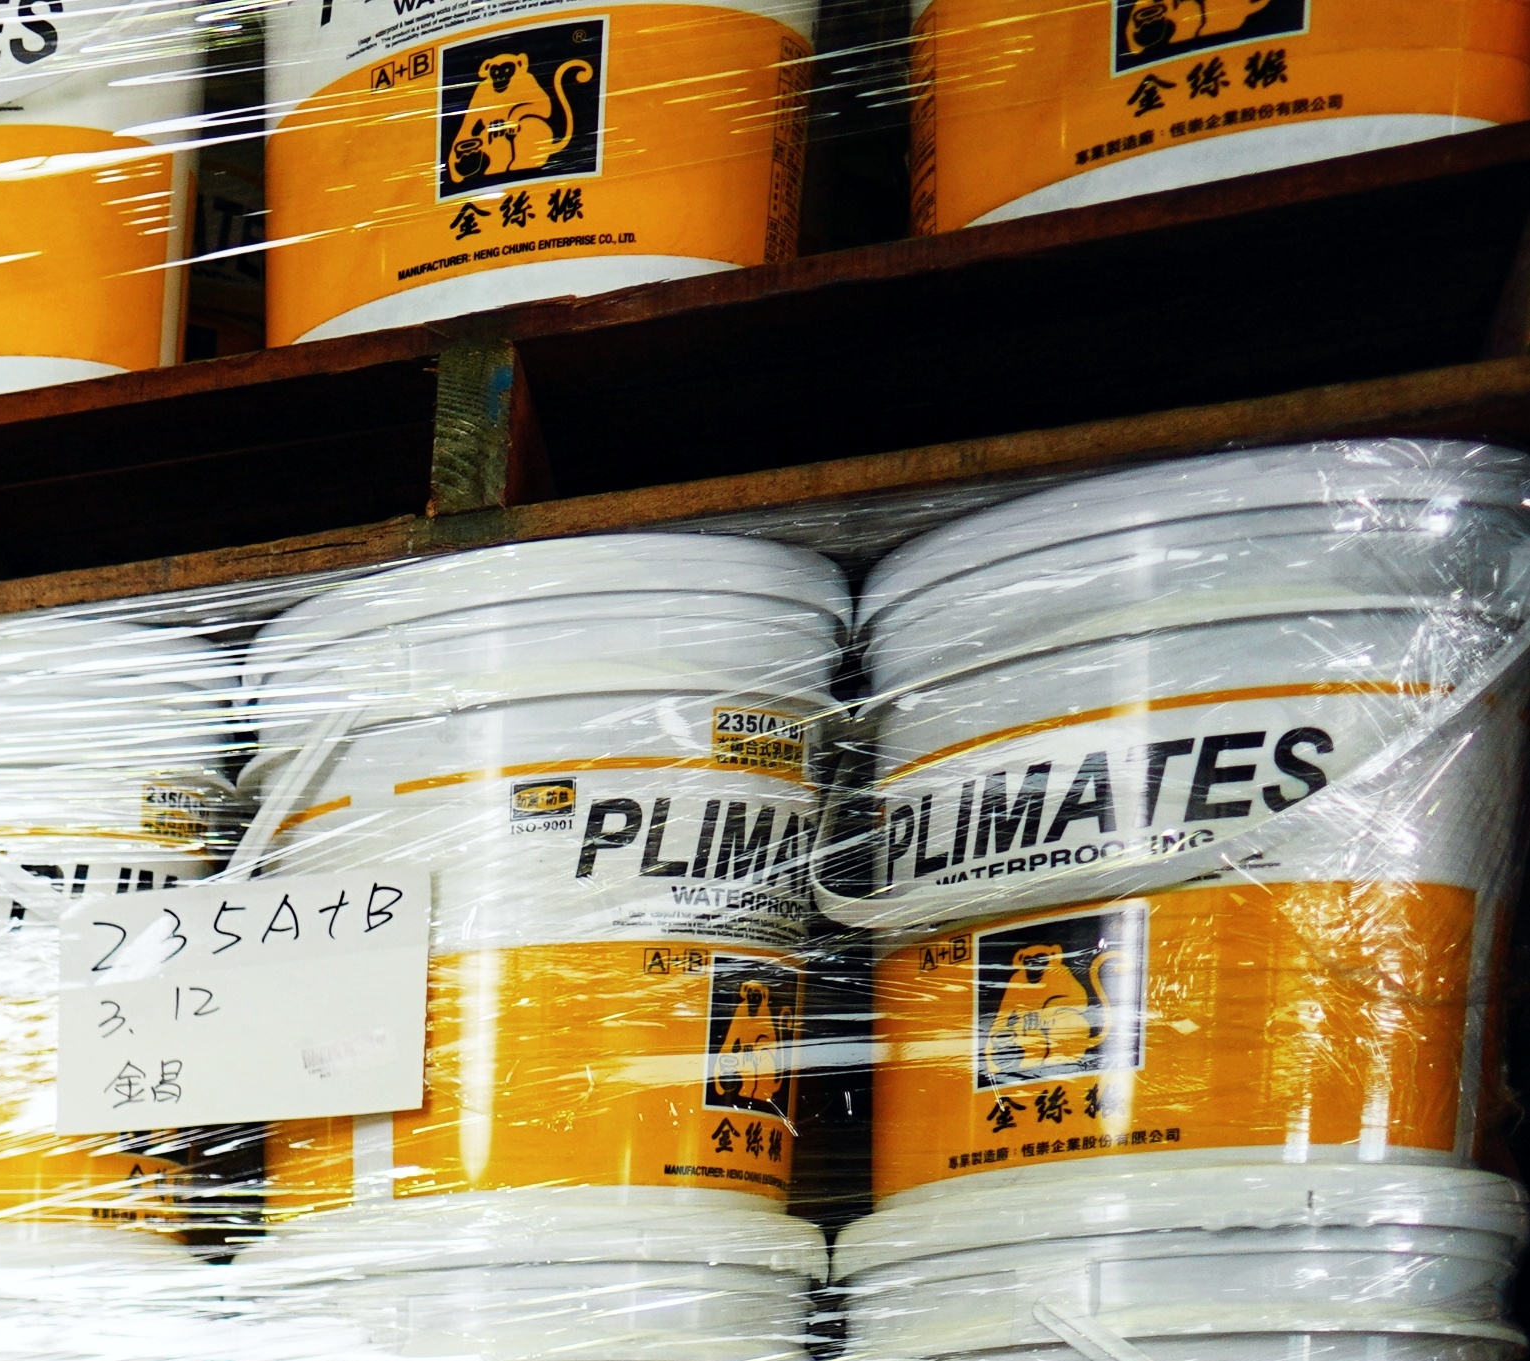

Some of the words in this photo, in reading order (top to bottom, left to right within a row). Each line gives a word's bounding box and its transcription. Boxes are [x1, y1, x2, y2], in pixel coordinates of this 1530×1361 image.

[398, 253, 471, 281] MANUFACTURER:
[474, 246, 500, 261] HENG
[502, 241, 536, 256] CHUNG
[538, 234, 596, 250] ENTERPRISE
[510, 820, 574, 835] ISO-9001
[883, 726, 1334, 892] PLIMATES
